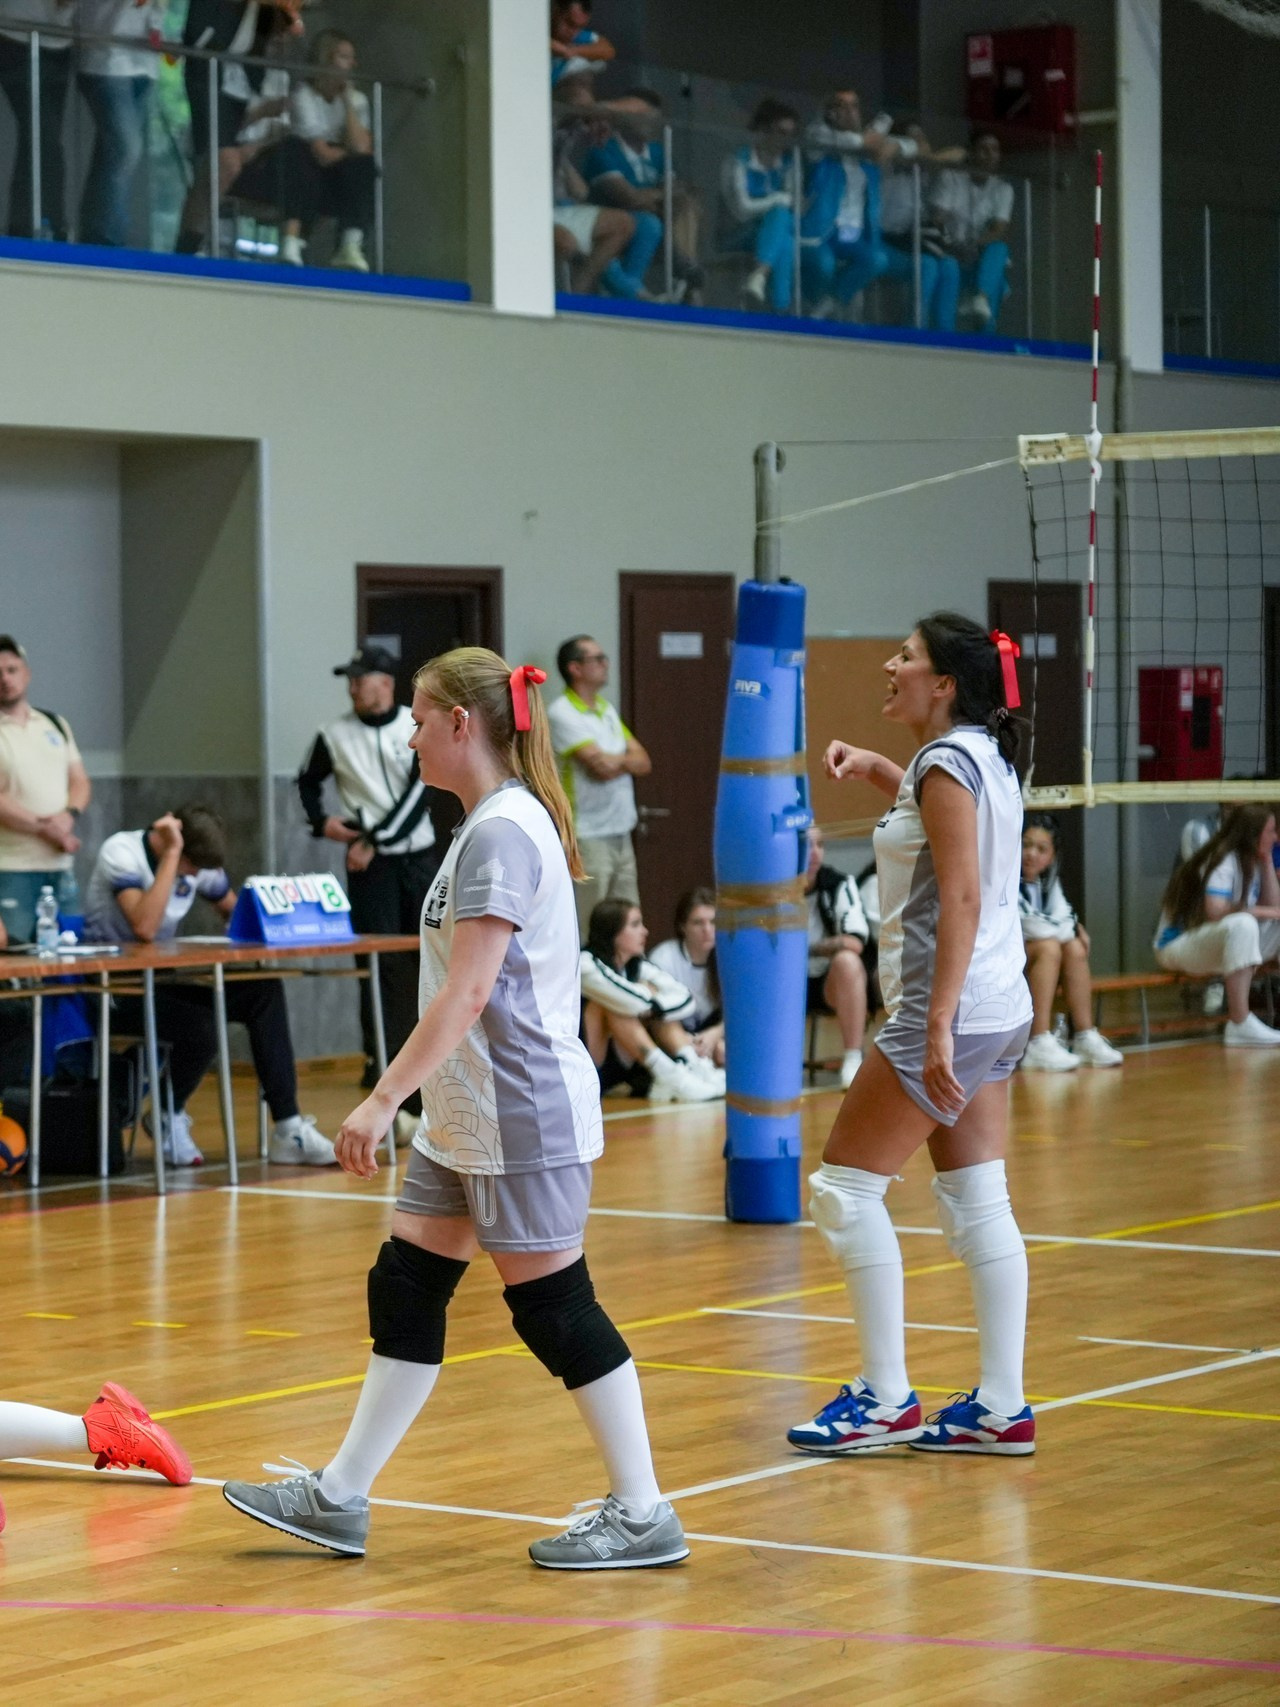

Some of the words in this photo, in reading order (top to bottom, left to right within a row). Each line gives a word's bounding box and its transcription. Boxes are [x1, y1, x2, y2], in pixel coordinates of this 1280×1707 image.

[322, 882, 343, 908] 8
[276, 1488, 313, 1517] N
[585, 1526, 630, 1560] N
